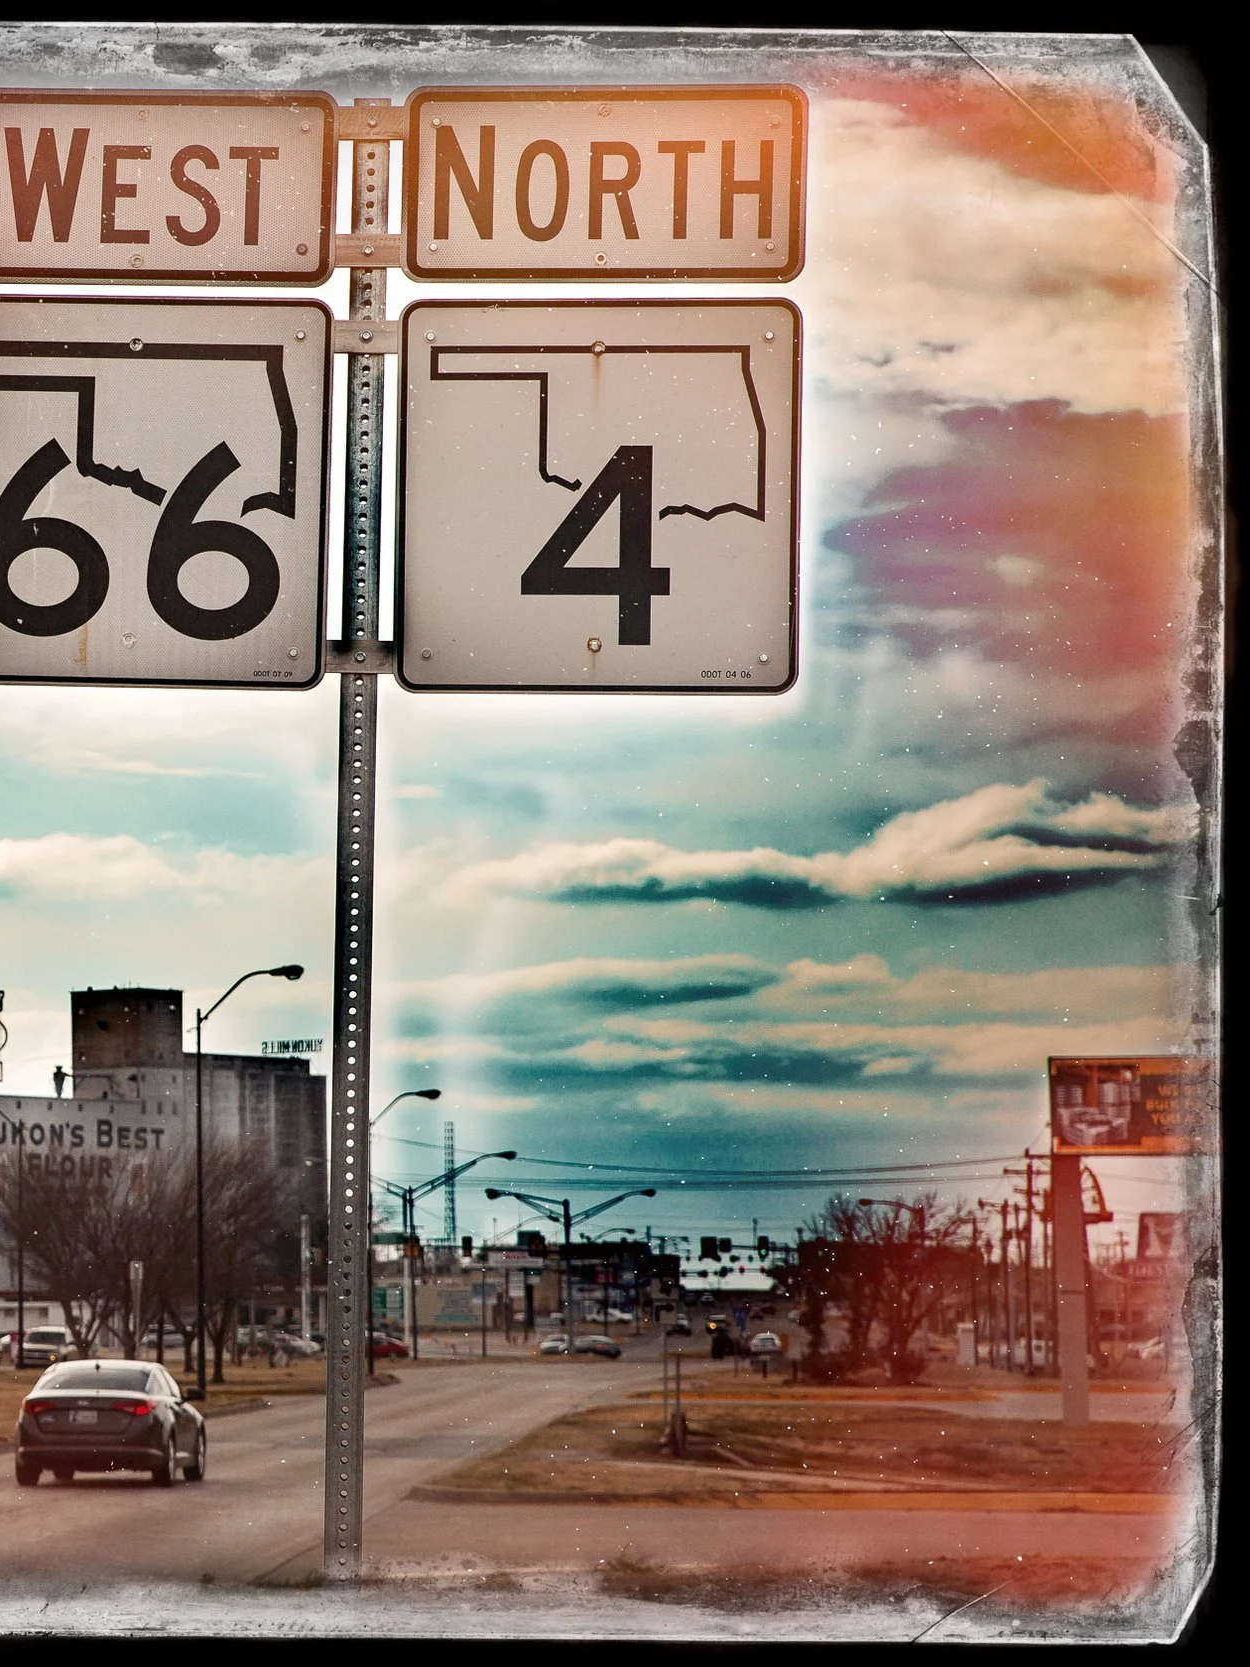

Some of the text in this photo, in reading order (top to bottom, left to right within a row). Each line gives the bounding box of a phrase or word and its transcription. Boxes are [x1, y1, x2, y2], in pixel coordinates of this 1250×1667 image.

[4, 127, 279, 246] WEST
[433, 124, 775, 242] NORTH
[520, 445, 670, 645] 4
[700, 670, 752, 679] ODOT 04 06
[28, 1152, 113, 1179] FLOUR
[96, 1118, 165, 1150] BEST
